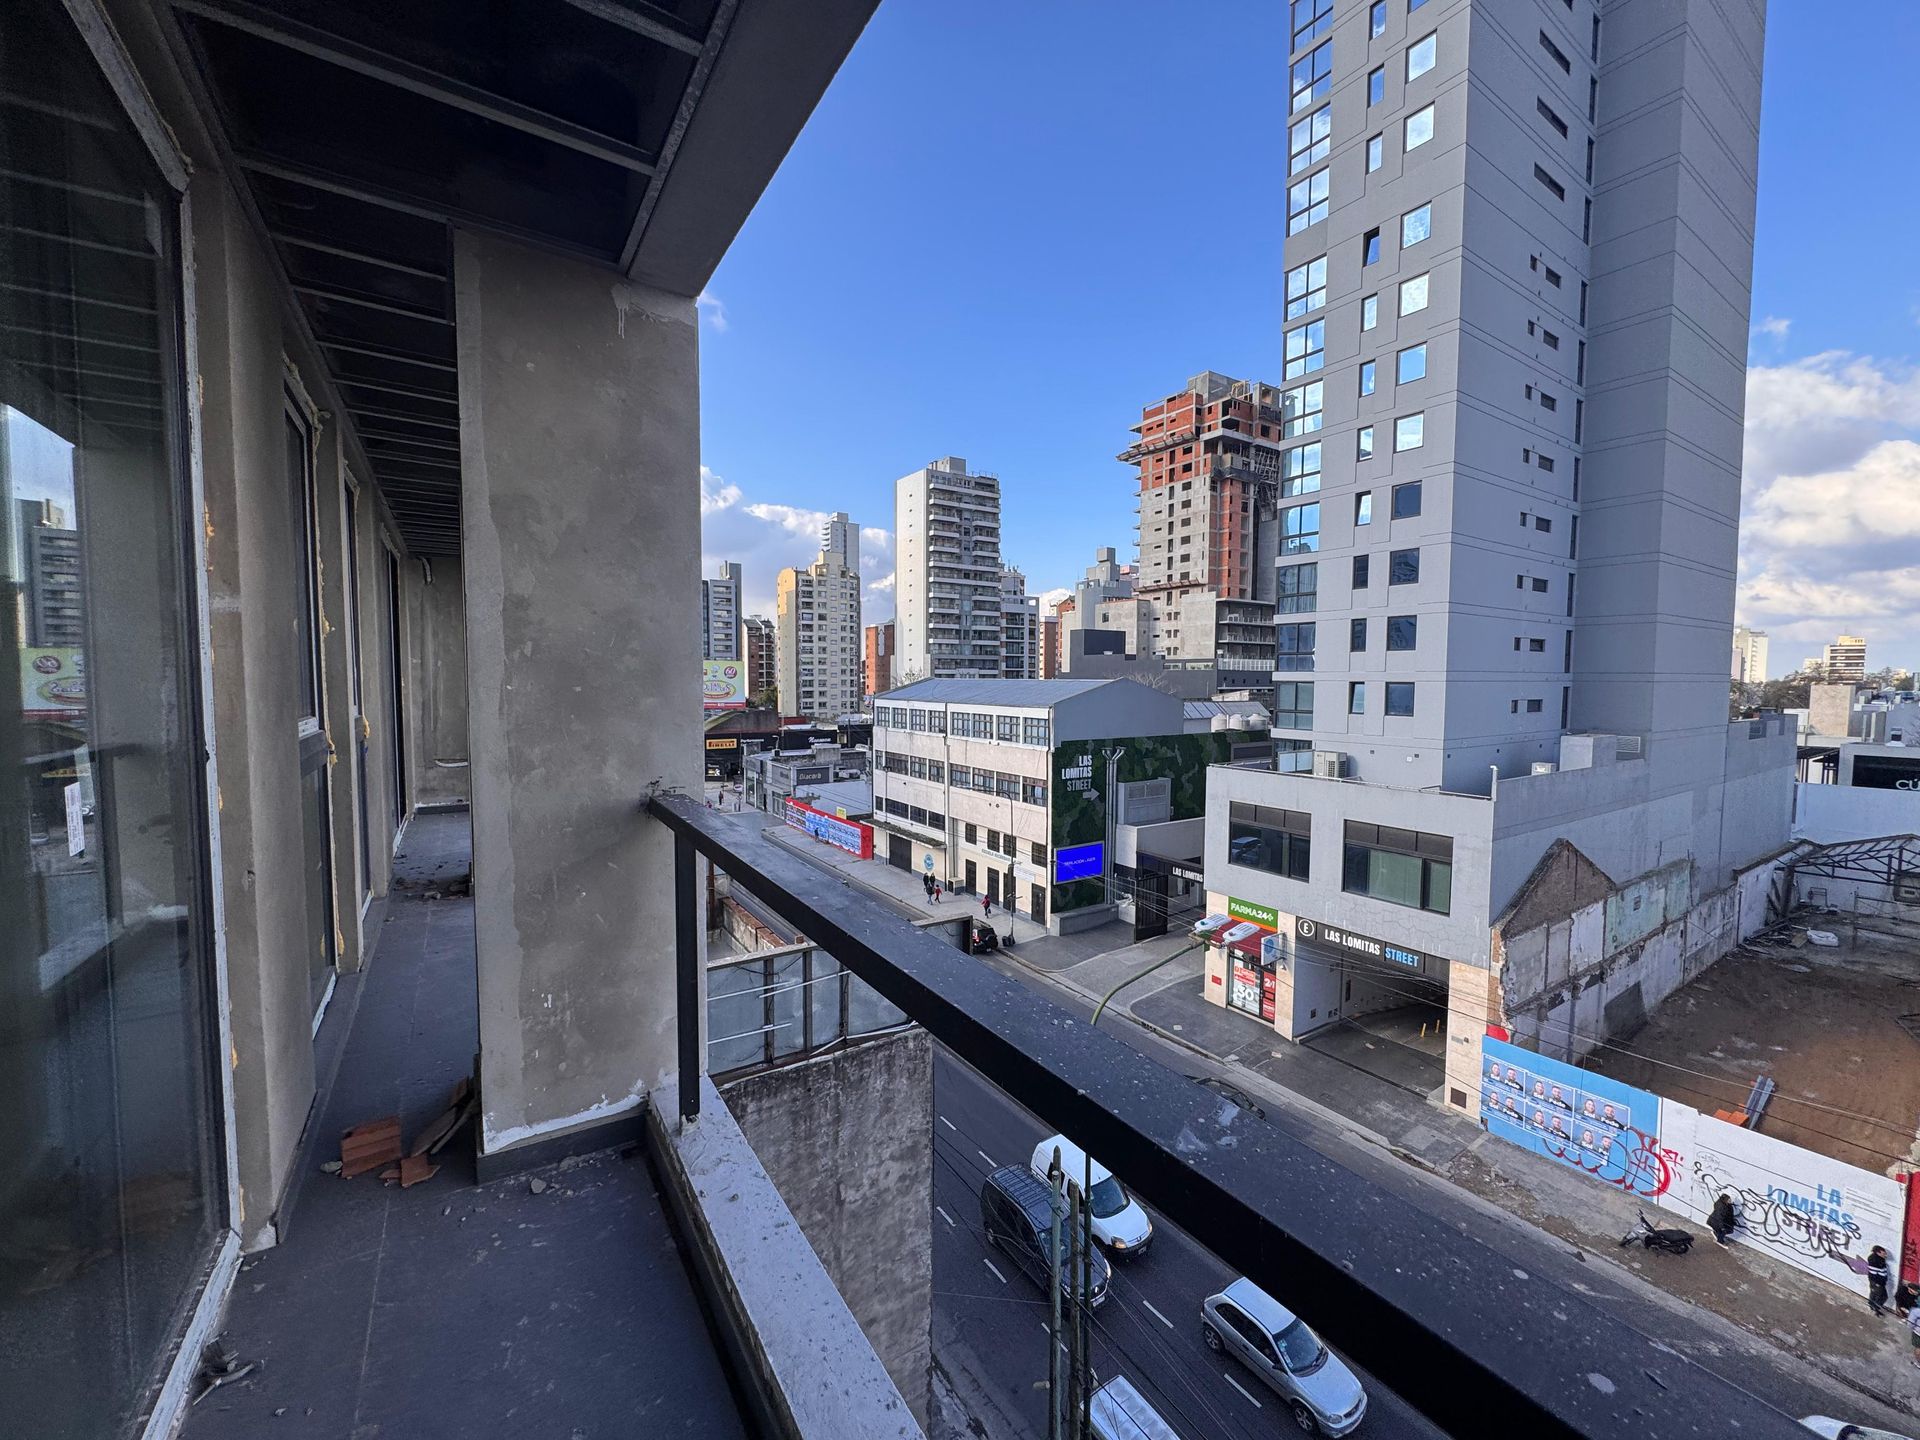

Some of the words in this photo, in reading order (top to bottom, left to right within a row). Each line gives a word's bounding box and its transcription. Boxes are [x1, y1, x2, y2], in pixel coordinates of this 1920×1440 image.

[1078, 755, 1092, 767] LAS
[1061, 767, 1092, 780] LOMITAS
[1066, 779, 1092, 791] STREET
[1172, 866, 1182, 877] LAS
[1182, 870, 1203, 883] LOMITAS
[1303, 923, 1309, 934] E
[1324, 929, 1340, 943] LAS
[1342, 934, 1380, 956] LOMITAS
[1385, 947, 1419, 967] STREET
[1817, 1184, 1842, 1207] LA
